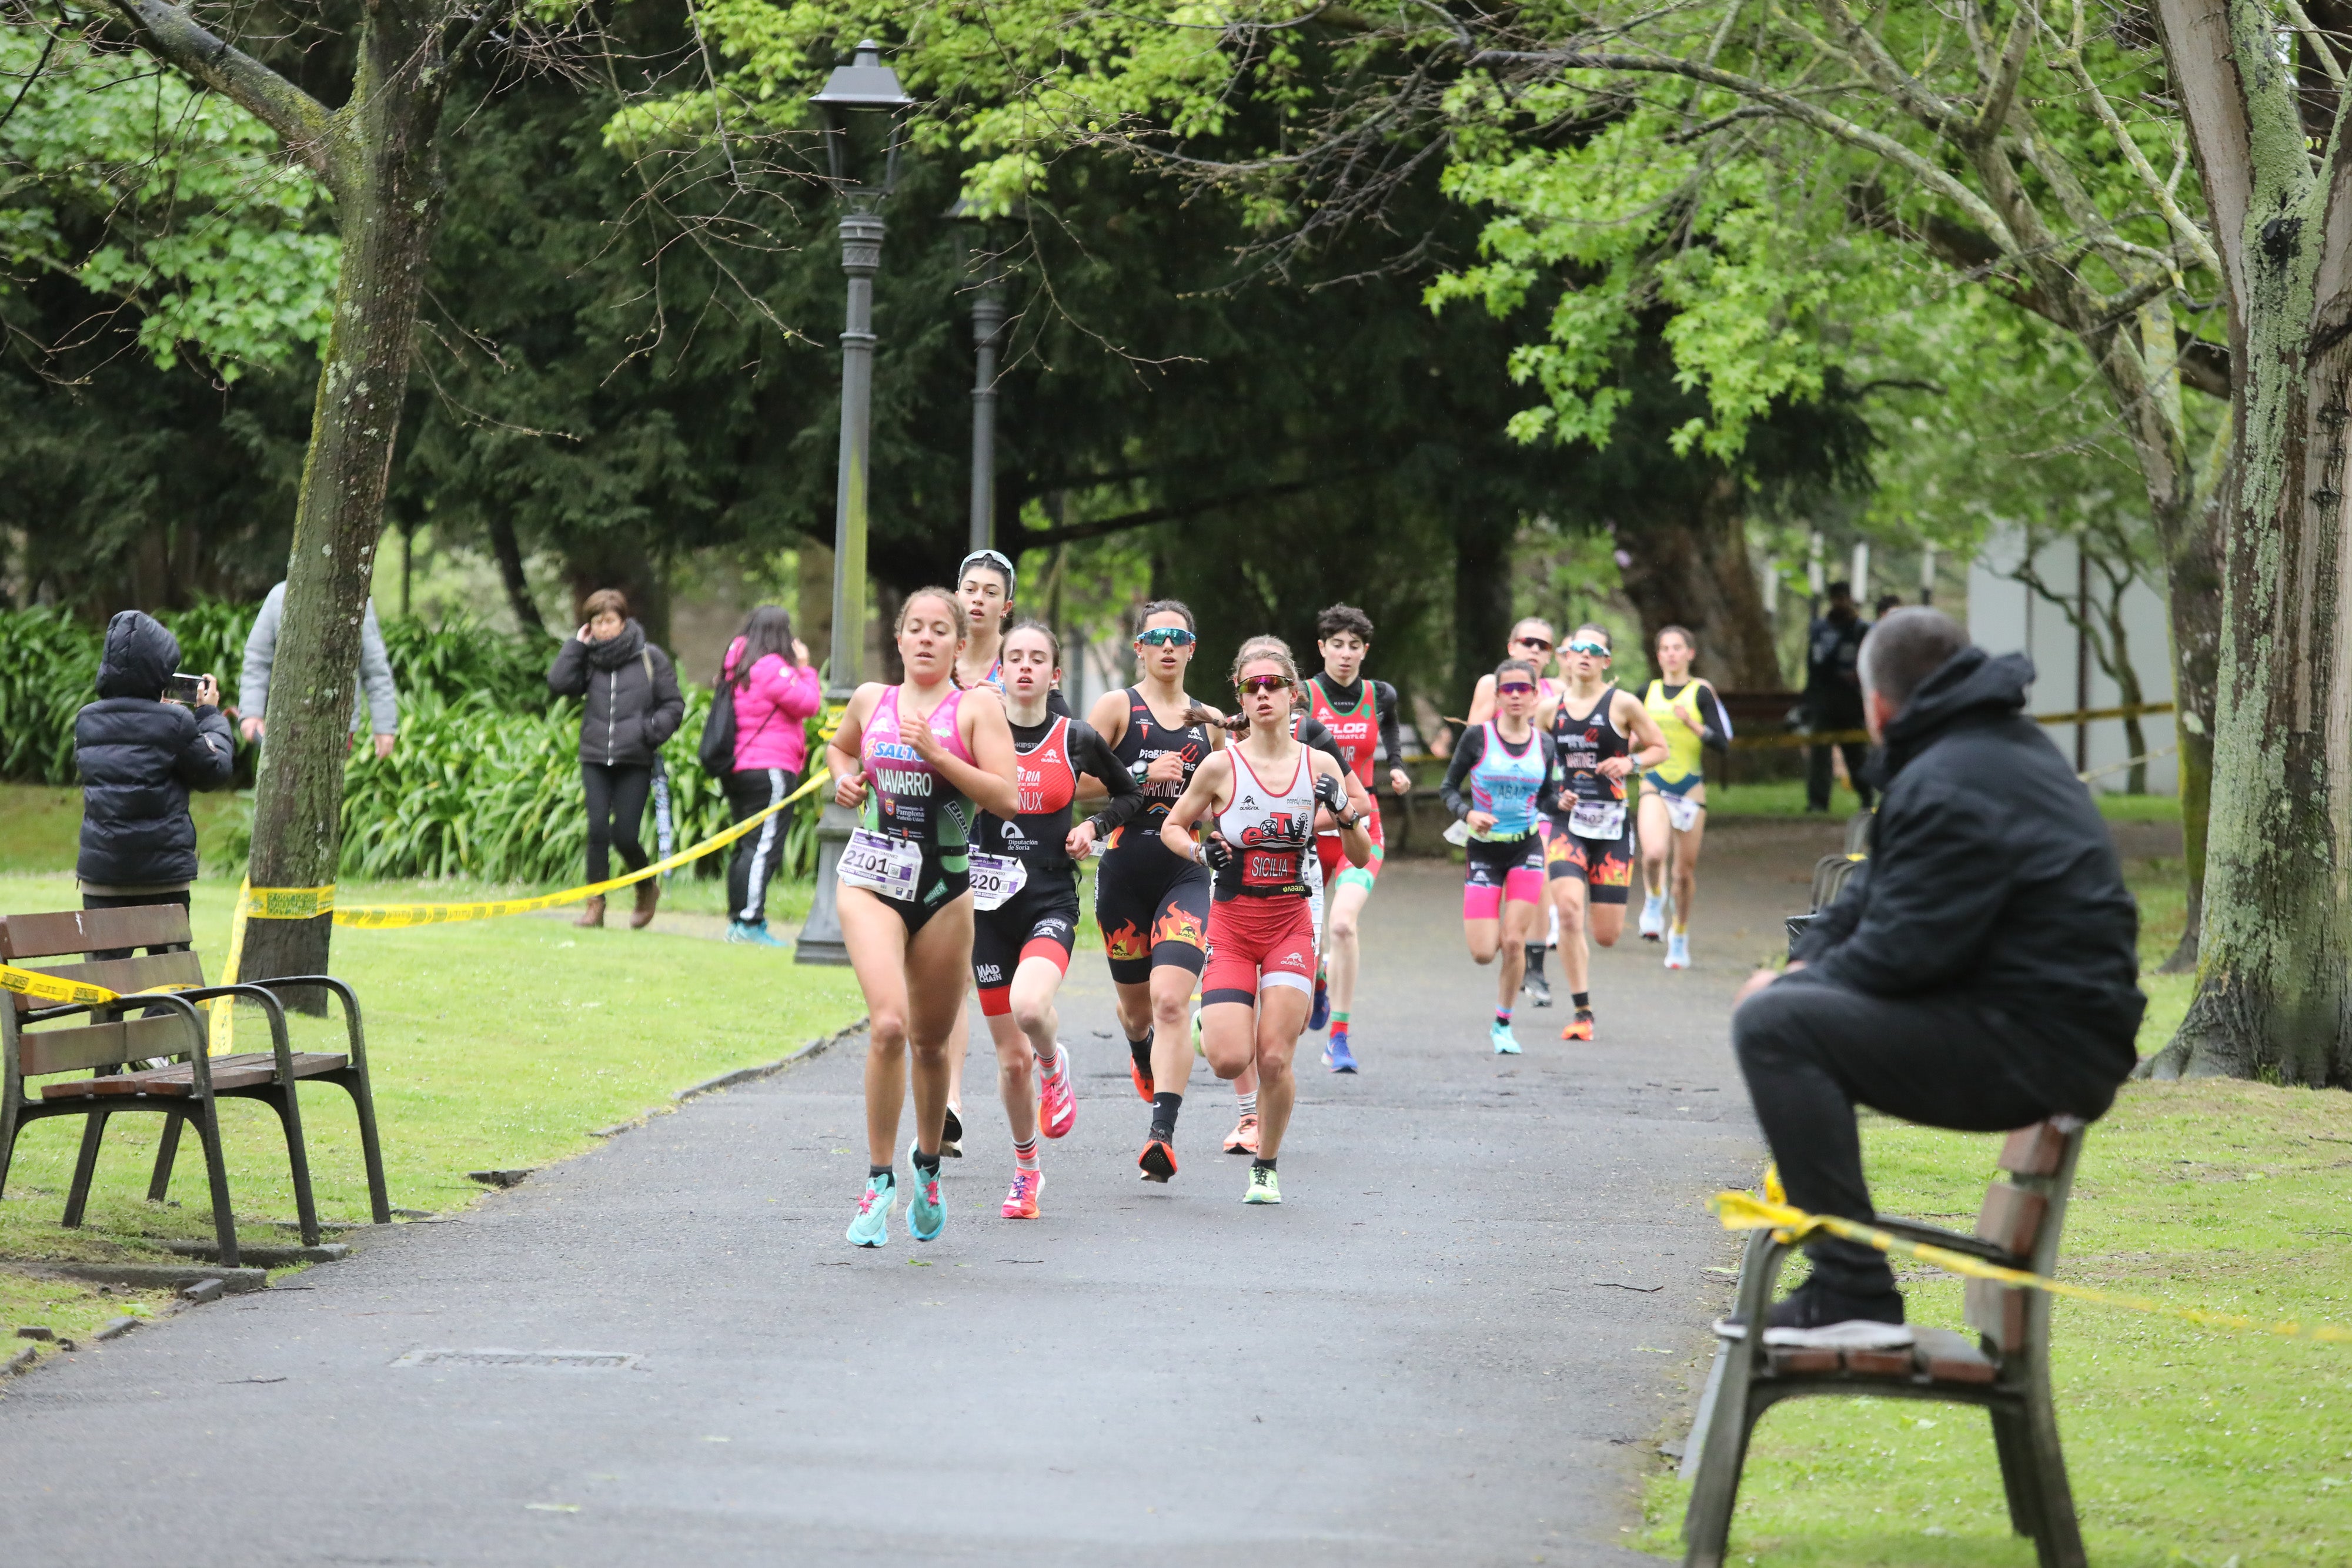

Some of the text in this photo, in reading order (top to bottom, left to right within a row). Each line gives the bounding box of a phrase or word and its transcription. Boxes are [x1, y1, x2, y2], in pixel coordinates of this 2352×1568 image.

[876, 768, 933, 797] NAVARRO
[1018, 788, 1044, 811] ÑUX
[896, 808, 924, 818] Pamplona
[843, 850, 888, 875] 2101
[1251, 856, 1288, 877] SICILIA
[970, 874, 1000, 891] 220
[976, 963, 1000, 977] MAD
